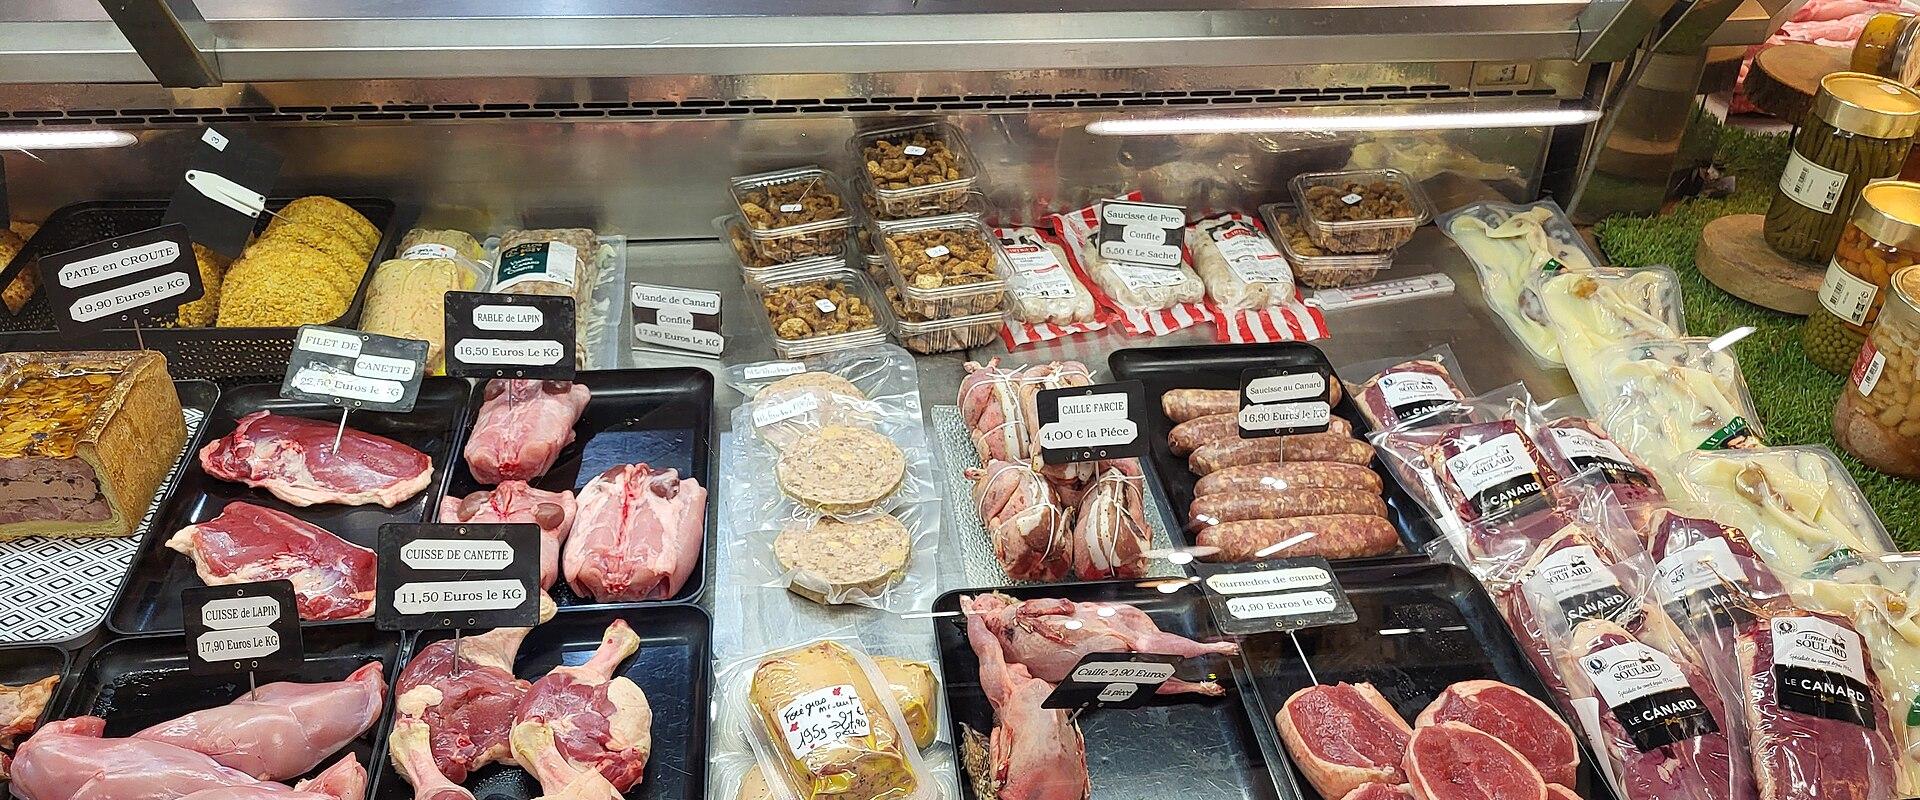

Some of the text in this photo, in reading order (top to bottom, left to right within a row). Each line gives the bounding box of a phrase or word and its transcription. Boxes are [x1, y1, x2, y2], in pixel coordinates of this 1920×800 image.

[1107, 210, 1180, 223] Saucisse de Porc
[1129, 230, 1160, 241] Confite
[1105, 246, 1177, 260] 5,50 € Le Sachet
[64, 247, 175, 281] PATE en CROUTE
[78, 278, 185, 315] 19,90 Euros le KG
[636, 292, 716, 308] Viande de Canard
[477, 313, 540, 323] RABLE de LAPIN
[659, 314, 692, 325] Confite
[305, 335, 359, 351] FILET DE
[638, 328, 719, 347] 17,90 Euros Le KG
[460, 346, 560, 357] 16,50 Euros Le KG
[356, 360, 411, 375] CANETTE
[334, 380, 367, 393] Euros
[386, 388, 400, 397] G
[1250, 381, 1322, 395] Saucisse au Canard
[1062, 402, 1124, 415] CAILLE FARCIE
[1244, 412, 1270, 423] 16,90
[1272, 411, 1300, 421] Euros
[1302, 410, 1311, 419] le
[1044, 430, 1073, 441] 4,00
[1076, 430, 1084, 438] €
[1087, 428, 1097, 438] la
[1471, 455, 1515, 477] SOULARD
[1490, 481, 1541, 506] CANARD
[406, 548, 509, 561] CUISSE DE CANETTE
[1212, 573, 1327, 589] Tournedos de canard
[402, 589, 522, 604] 11,50 Euros le KG
[1231, 596, 1334, 613] 24,90 Euros le KG
[205, 605, 277, 621] CUISSE de LAPIN
[200, 636, 278, 653] 17,90 Euros Le KG
[1803, 633, 1828, 643] Ernest
[1795, 639, 1848, 659] SOULARD
[1077, 668, 1168, 679] Caille 2,90 Euros
[1613, 663, 1661, 682] SOULARD
[1785, 677, 1865, 702] LE CANARD
[1628, 699, 1698, 726] LE CANARD
